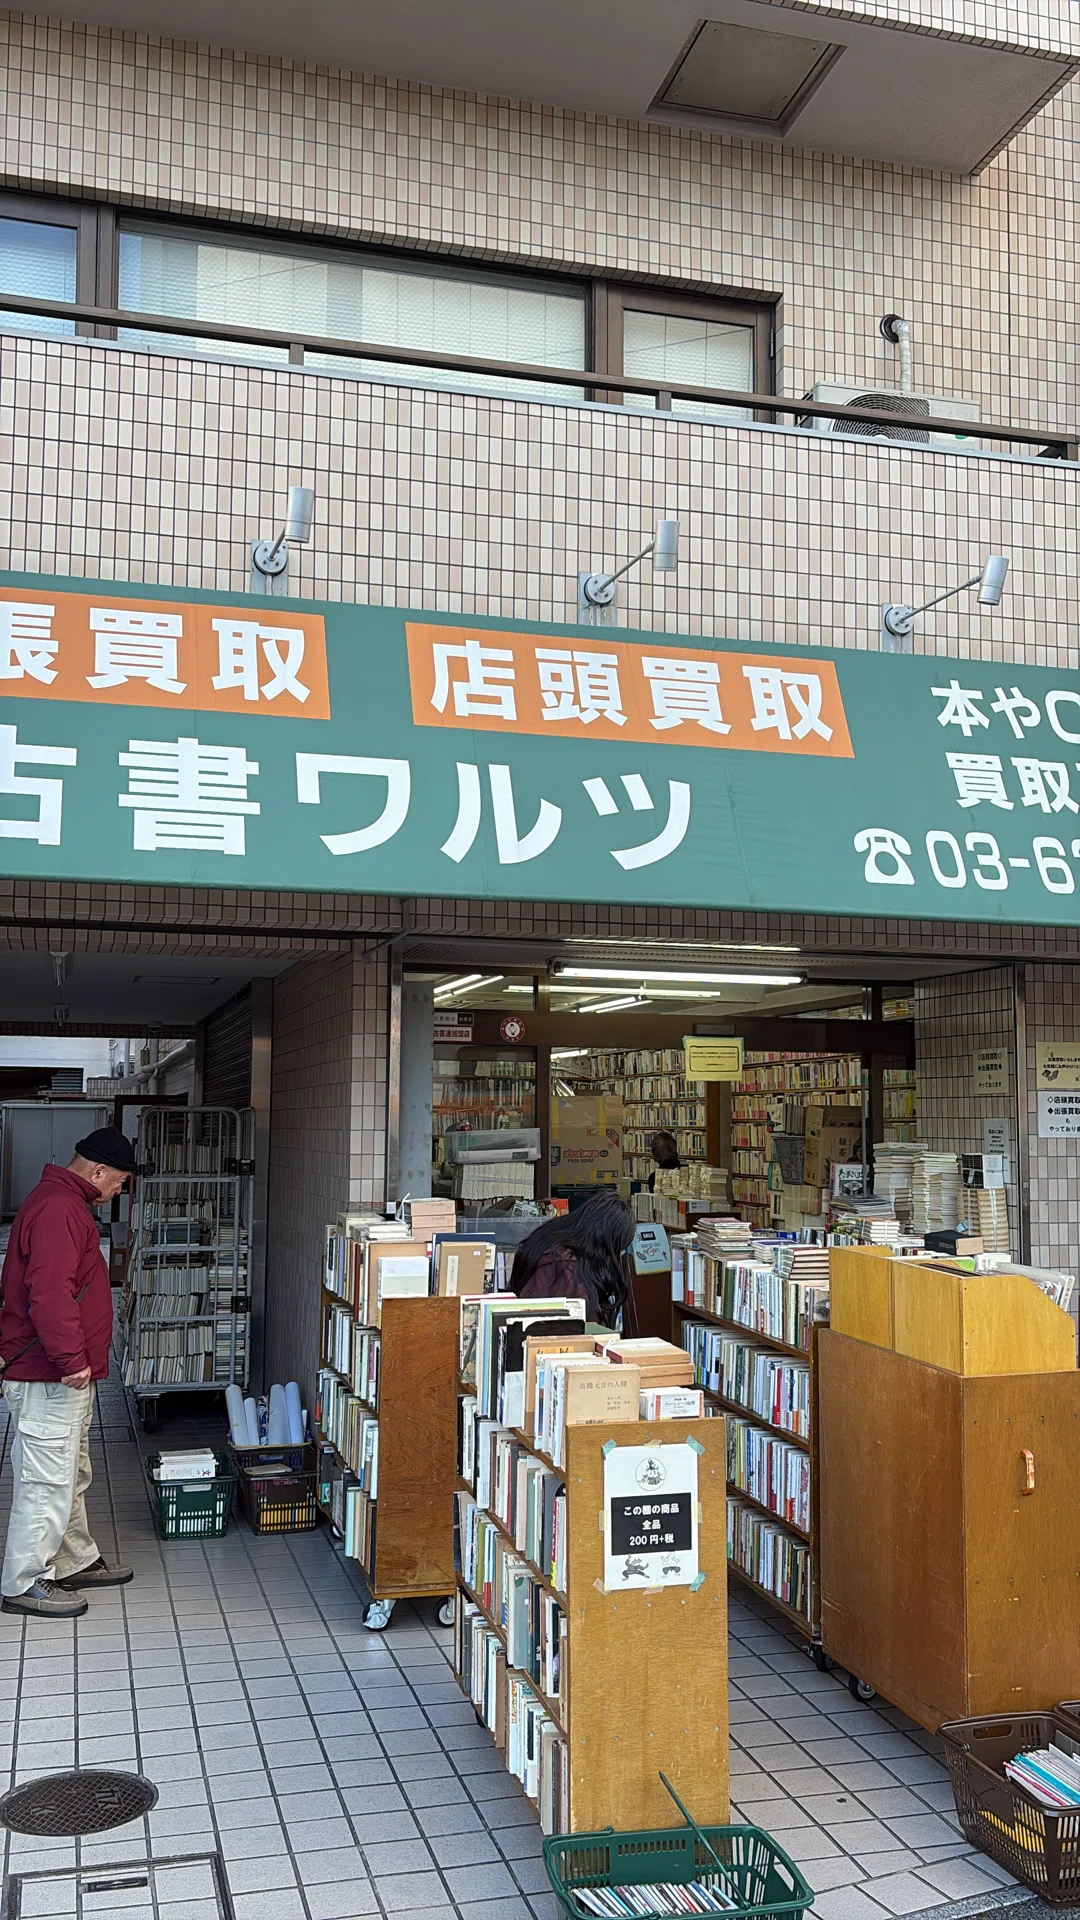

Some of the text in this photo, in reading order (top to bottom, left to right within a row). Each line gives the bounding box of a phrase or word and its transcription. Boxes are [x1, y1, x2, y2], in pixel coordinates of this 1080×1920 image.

[430, 640, 834, 742] 店頭買取
[0, 725, 691, 871] 古書ワルツ
[945, 752, 1080, 815] 買取
[925, 830, 1080, 894] 03-6
[579, 1380, 629, 1390] 高橋元吉の人間
[624, 1503, 680, 1516] この棚の商品
[642, 1520, 661, 1530] 全品
[629, 1533, 674, 1546] 200 円+税
